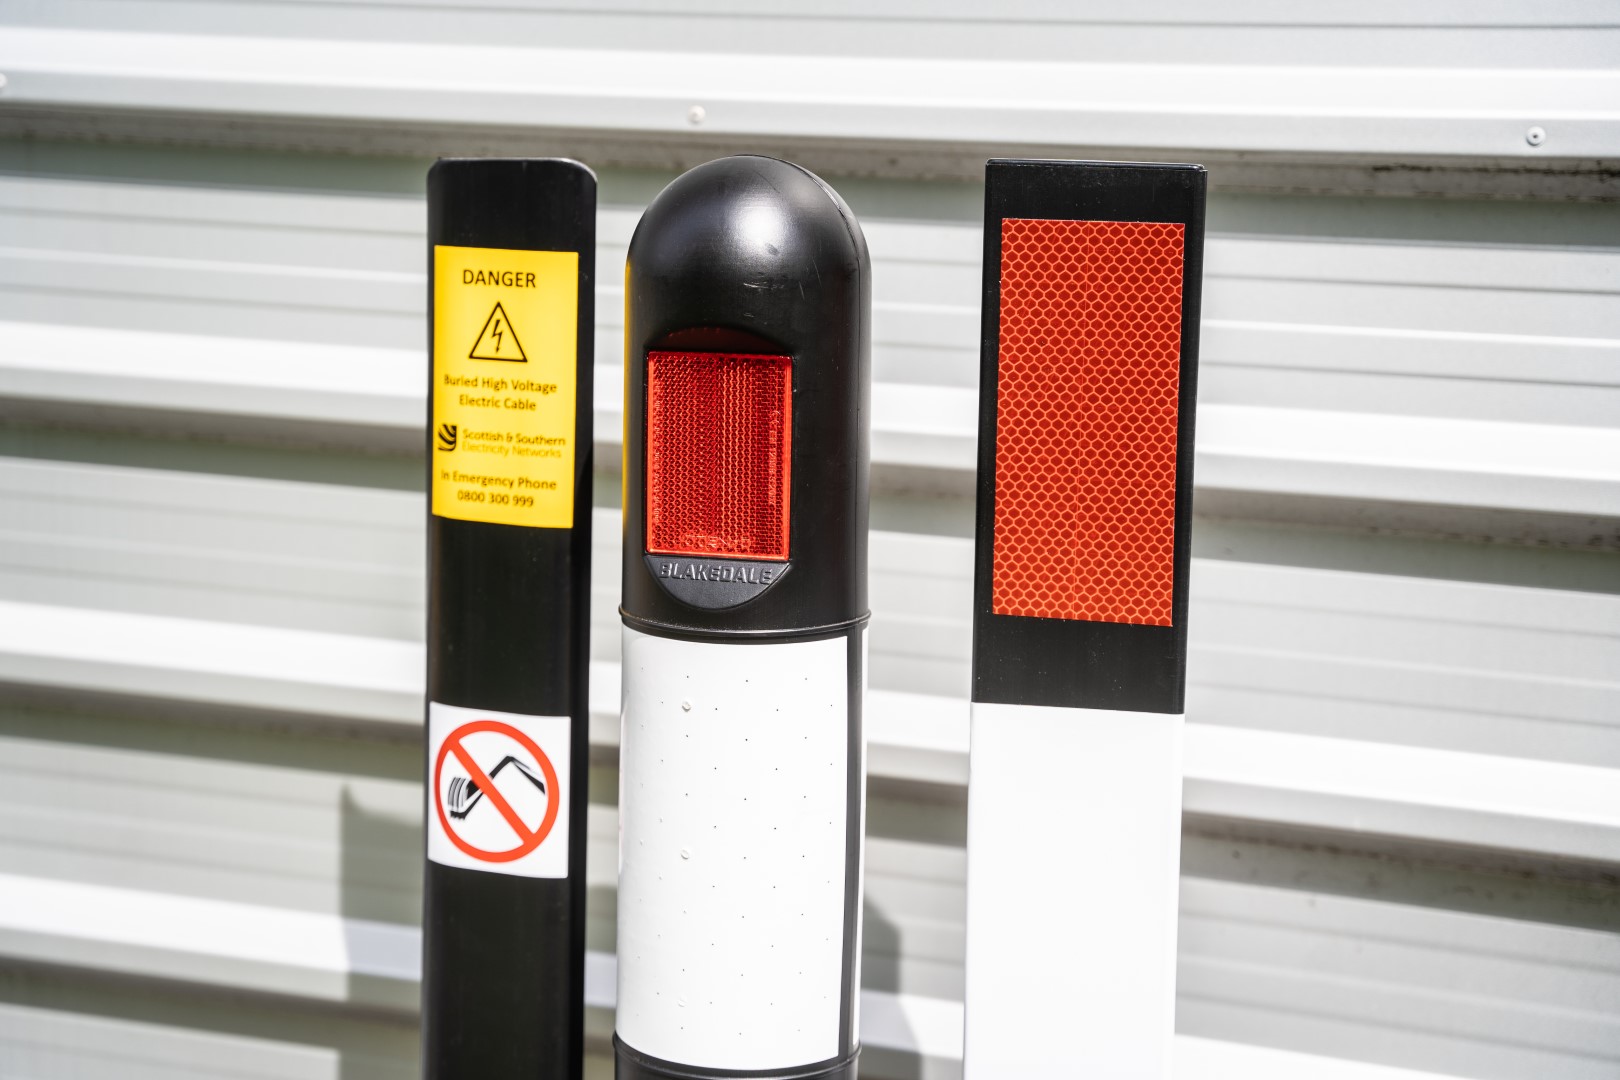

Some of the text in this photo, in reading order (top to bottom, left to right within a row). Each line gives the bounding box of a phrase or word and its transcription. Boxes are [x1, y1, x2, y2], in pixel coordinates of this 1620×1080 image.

[462, 269, 536, 288] DANGER
[444, 374, 557, 395] Buried High Voltage
[459, 394, 537, 411] Electric Cable
[462, 429, 566, 446] Scottish & Southern
[462, 442, 561, 458] Electricity Networks
[441, 469, 557, 490] In Emergency Phone
[457, 490, 534, 507] 0800 300 999
[659, 562, 773, 585] BLAKEDALE
